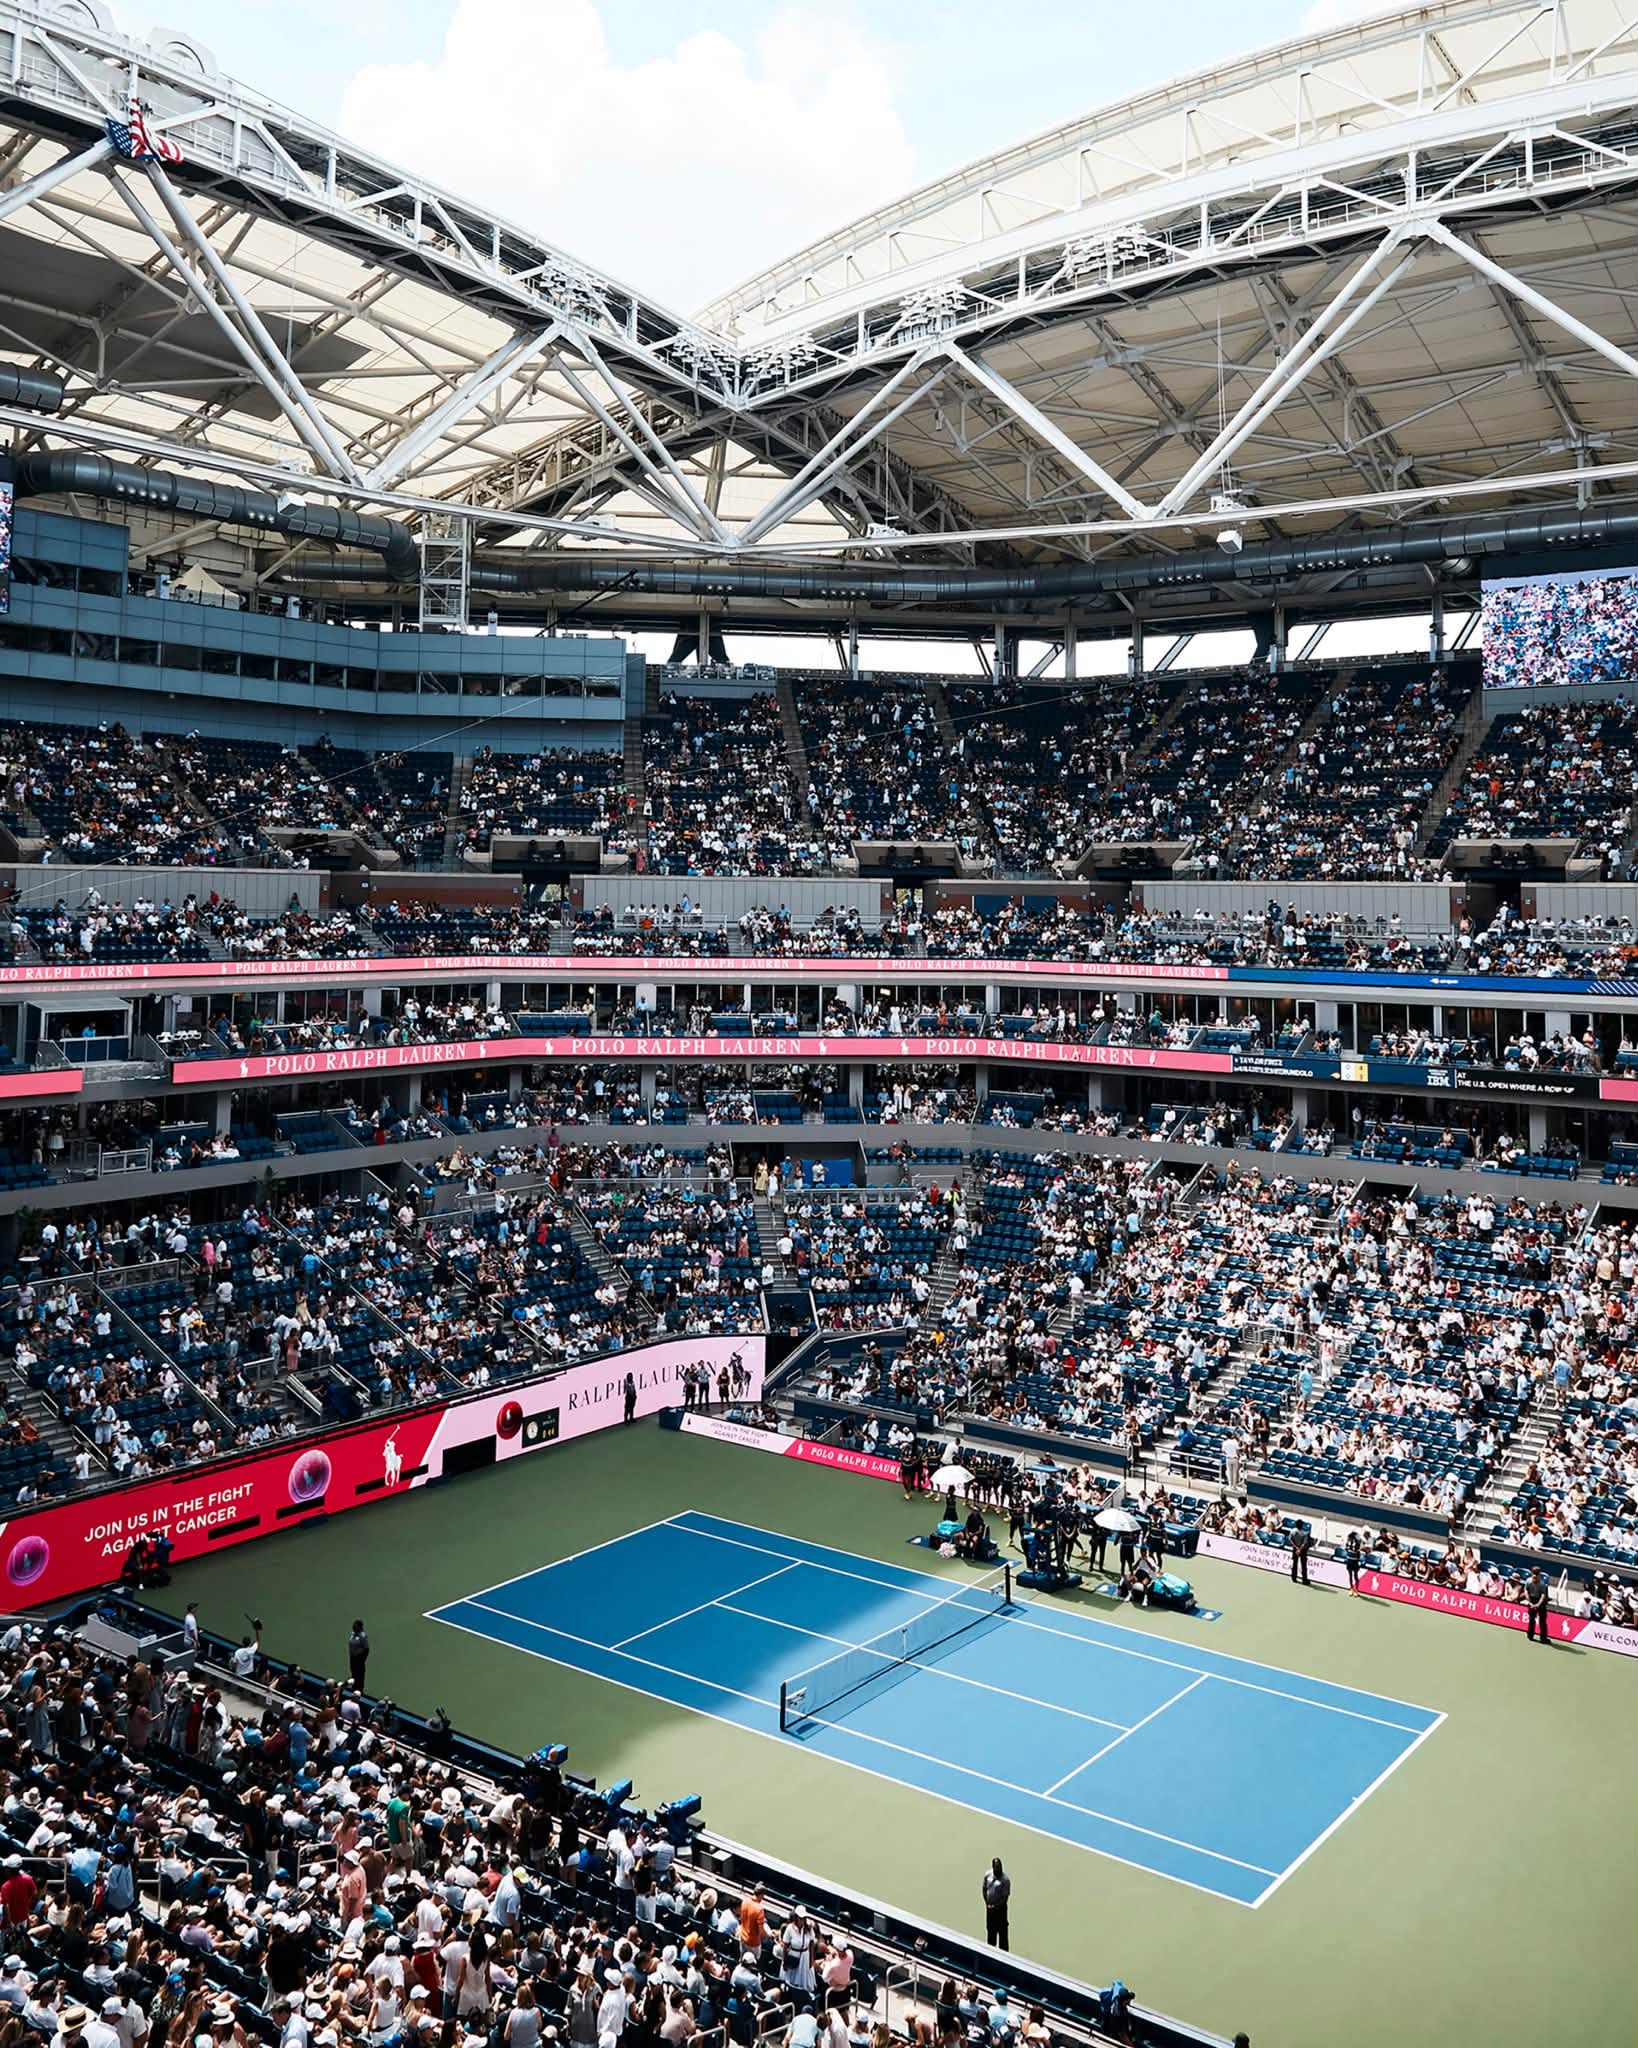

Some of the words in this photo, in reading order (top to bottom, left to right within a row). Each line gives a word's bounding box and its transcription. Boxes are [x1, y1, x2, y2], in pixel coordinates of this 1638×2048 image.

[236, 962, 265, 974] POLO
[271, 961, 308, 973] RALPH
[315, 960, 357, 972] LAUREN
[435, 958, 460, 968] POLO
[464, 957, 500, 968] RALPH
[508, 957, 556, 968] LAUREN
[658, 958, 689, 968] POLO
[695, 958, 735, 968] RALPH
[742, 958, 789, 969] LAUREN
[892, 960, 921, 969] POLO
[928, 960, 965, 970] RALPH
[973, 960, 1017, 970] LAUREN
[25, 967, 72, 979] RALPH
[80, 965, 134, 978] LAUREN
[1082, 964, 1111, 974] POLO
[1116, 965, 1153, 976] RALPH
[1159, 966, 1206, 977] LAUREN
[571, 1040, 625, 1055] POLO
[637, 1039, 705, 1055] RALPH
[719, 1039, 801, 1054] LAUREN
[926, 1039, 977, 1055] POLO
[987, 1040, 1047, 1059] RALPH
[266, 1055, 316, 1074] POLO
[326, 1049, 387, 1070] RALPH
[400, 1044, 467, 1064] LAUREN
[1426, 1075, 1451, 1087] IBM
[1457, 1079, 1472, 1087] THE
[1488, 1081, 1509, 1089] OPEN
[1509, 1082, 1537, 1092] WHERE
[568, 1378, 627, 1410] RALPH
[639, 1360, 717, 1390] LAURN
[810, 1447, 835, 1460] POLO
[837, 1453, 868, 1468] RALPH
[84, 1519, 123, 1542] JOIN
[127, 1513, 148, 1529] US
[152, 1507, 168, 1523] IN
[173, 1497, 204, 1516] THE
[208, 1482, 253, 1507] FIGHT
[175, 1506, 237, 1534] CANCER
[1239, 1544, 1258, 1555] JOIN
[1259, 1548, 1270, 1558] US
[1271, 1551, 1280, 1560] IN
[1246, 1554, 1280, 1569] AGAINST
[1391, 1581, 1426, 1599] POLO
[1431, 1591, 1478, 1611] RALPH
